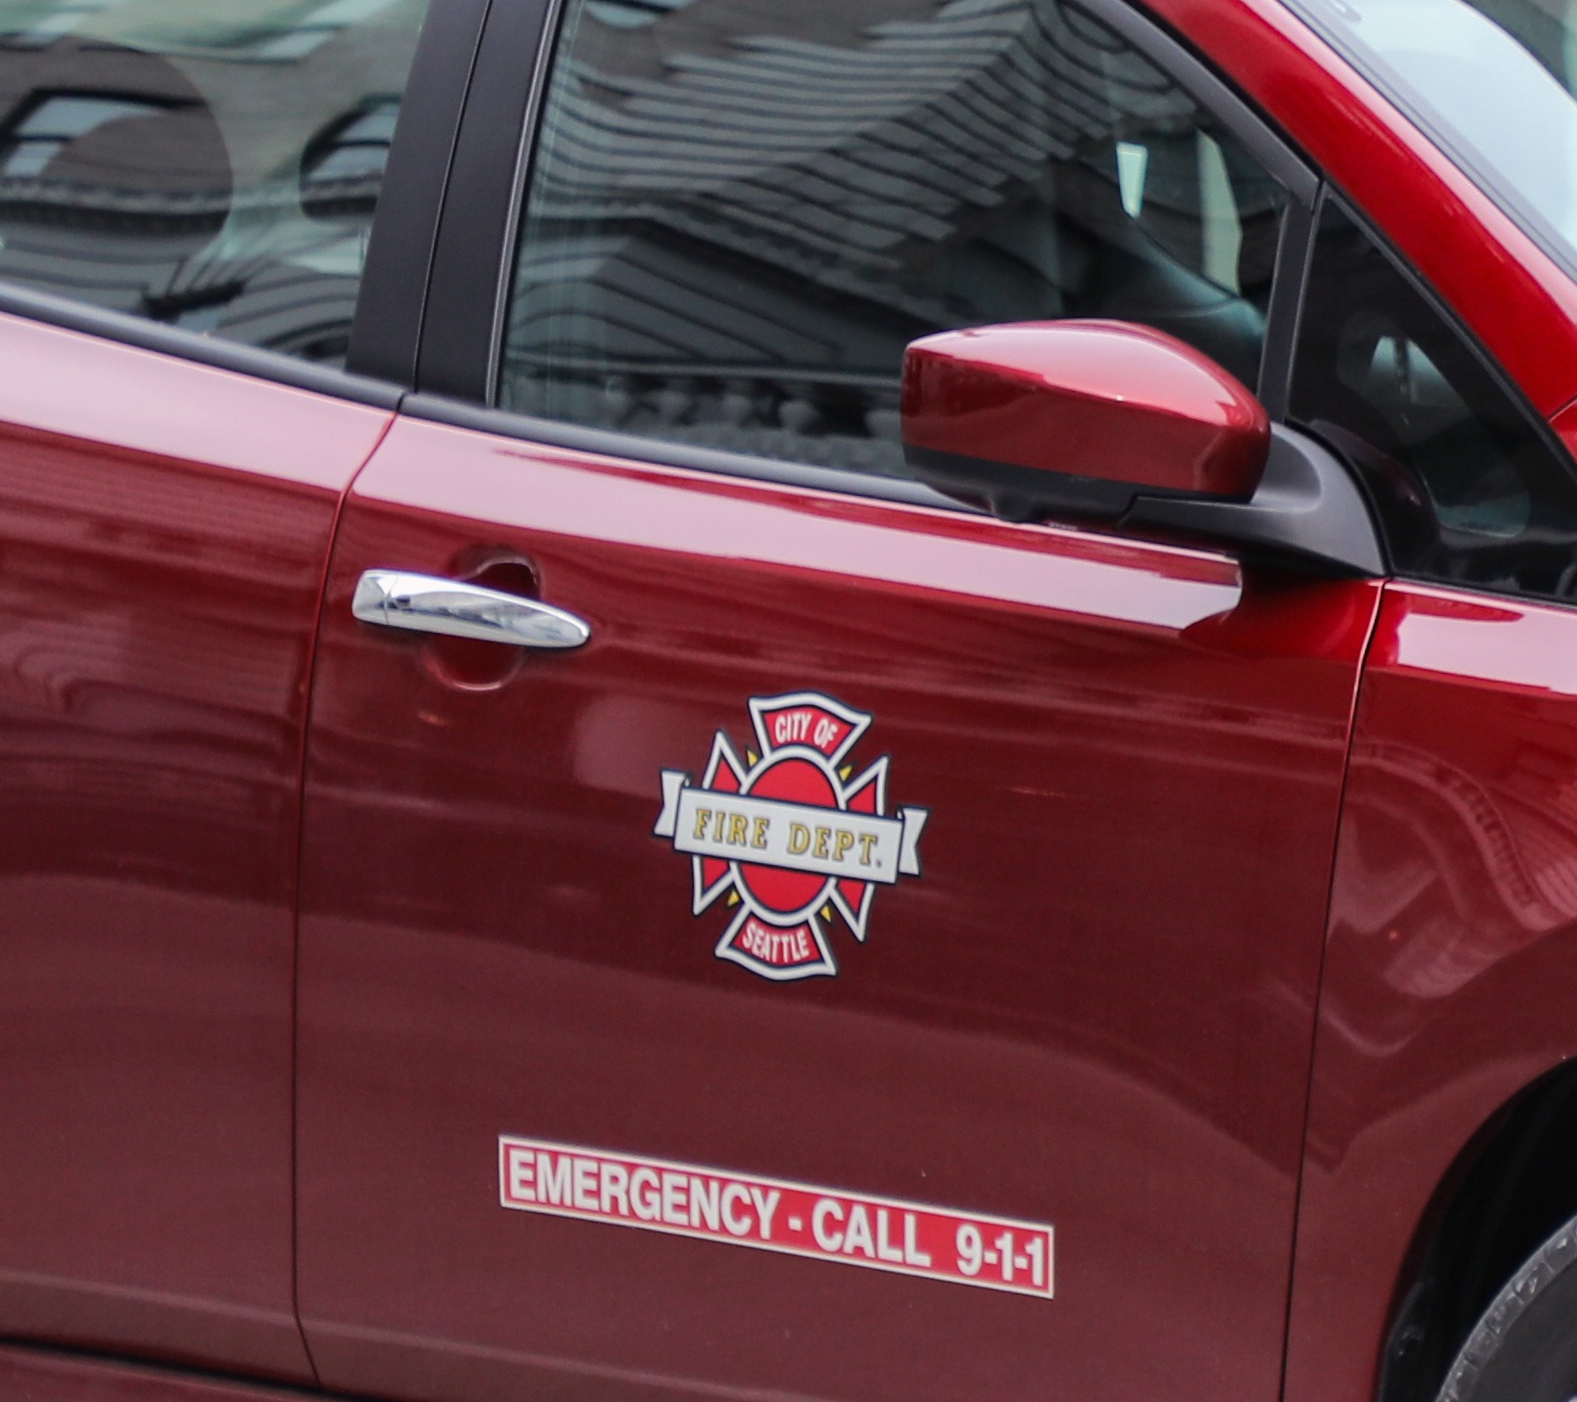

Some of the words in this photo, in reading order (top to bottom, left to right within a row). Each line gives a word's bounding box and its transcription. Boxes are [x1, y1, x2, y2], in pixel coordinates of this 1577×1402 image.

[775, 712, 812, 743] CITY
[813, 718, 838, 748] OF
[692, 808, 770, 849] FIRE
[786, 822, 883, 867] DEPT.
[741, 922, 810, 963] SEATTLE
[509, 1148, 780, 1240] EMERGENCY
[811, 1199, 931, 1268] CALL
[955, 1225, 1044, 1287] 9-1-1
